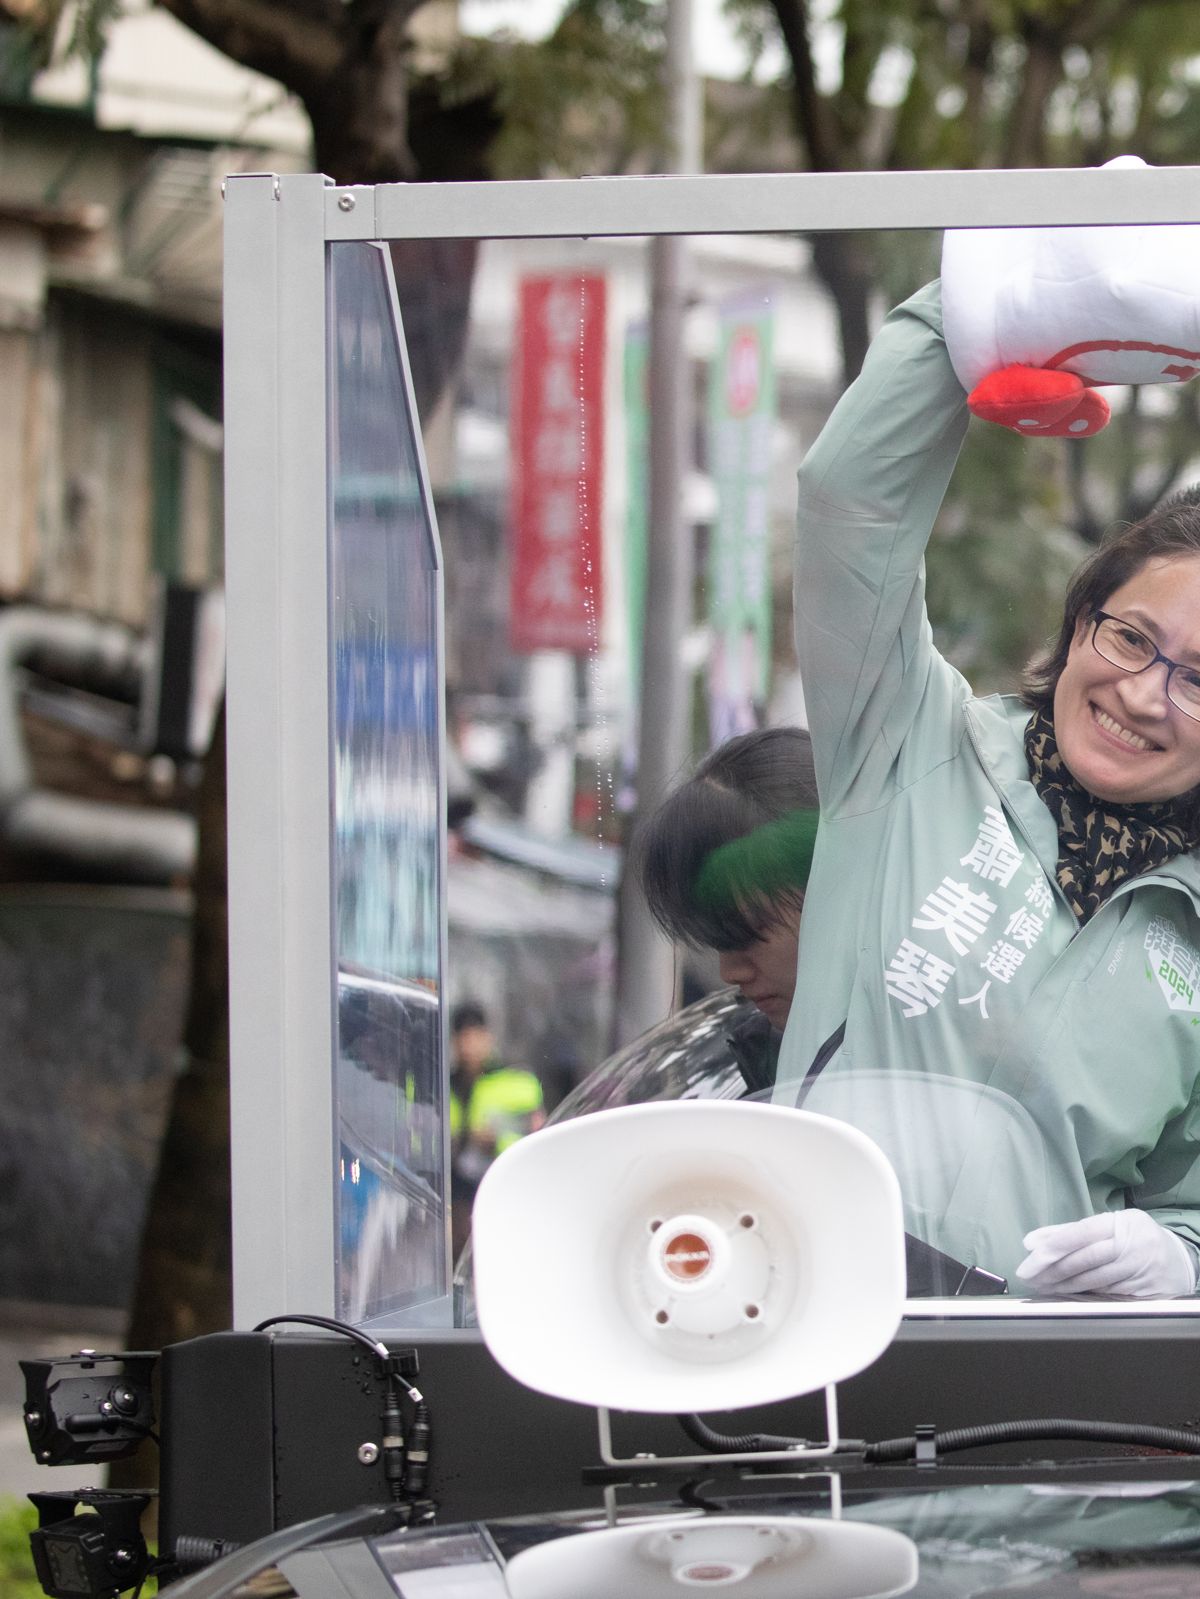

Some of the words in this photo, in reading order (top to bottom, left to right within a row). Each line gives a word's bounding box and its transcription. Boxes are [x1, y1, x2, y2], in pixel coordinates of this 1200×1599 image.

[885, 805, 1024, 1018] 蕭美琴
[958, 862, 1055, 1019] 統候選人
[1158, 959, 1194, 1006] 2024
